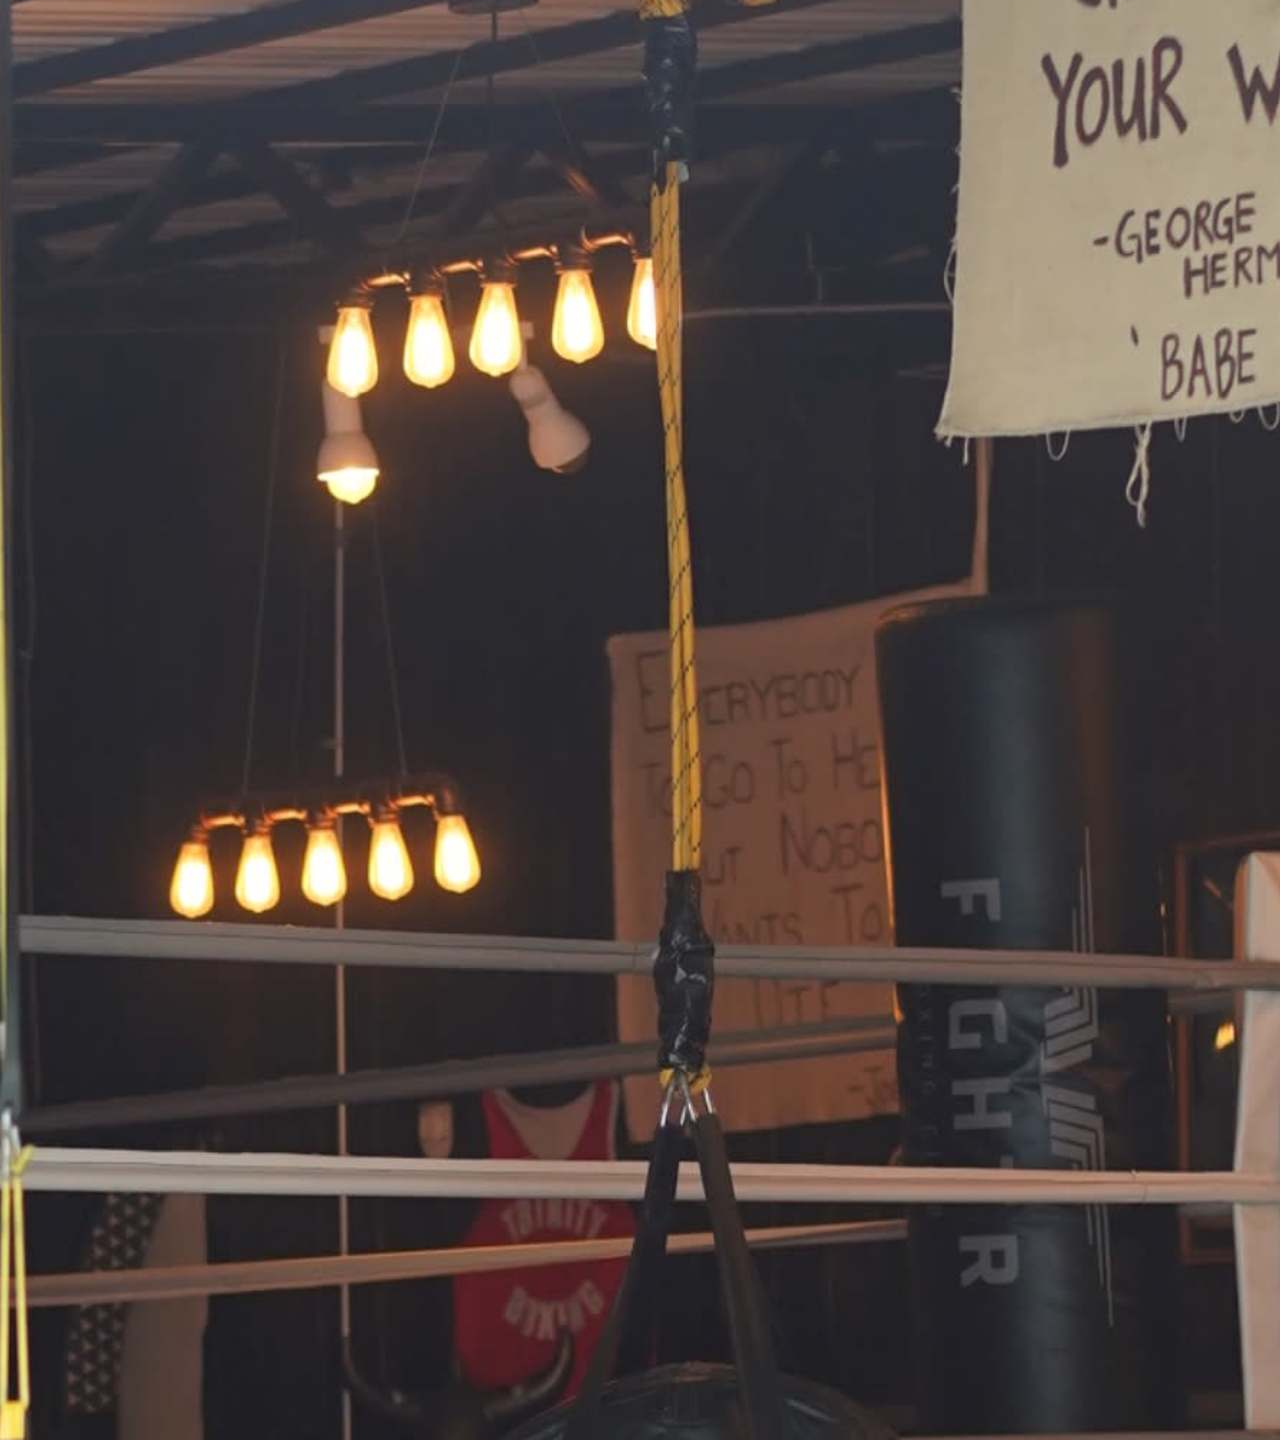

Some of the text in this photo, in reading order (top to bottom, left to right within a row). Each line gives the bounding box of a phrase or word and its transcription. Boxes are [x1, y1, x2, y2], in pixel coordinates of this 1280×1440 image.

[1041, 36, 1187, 168] YOUR
[634, 648, 863, 735] EERYBODY
[778, 805, 883, 876] NOBO
